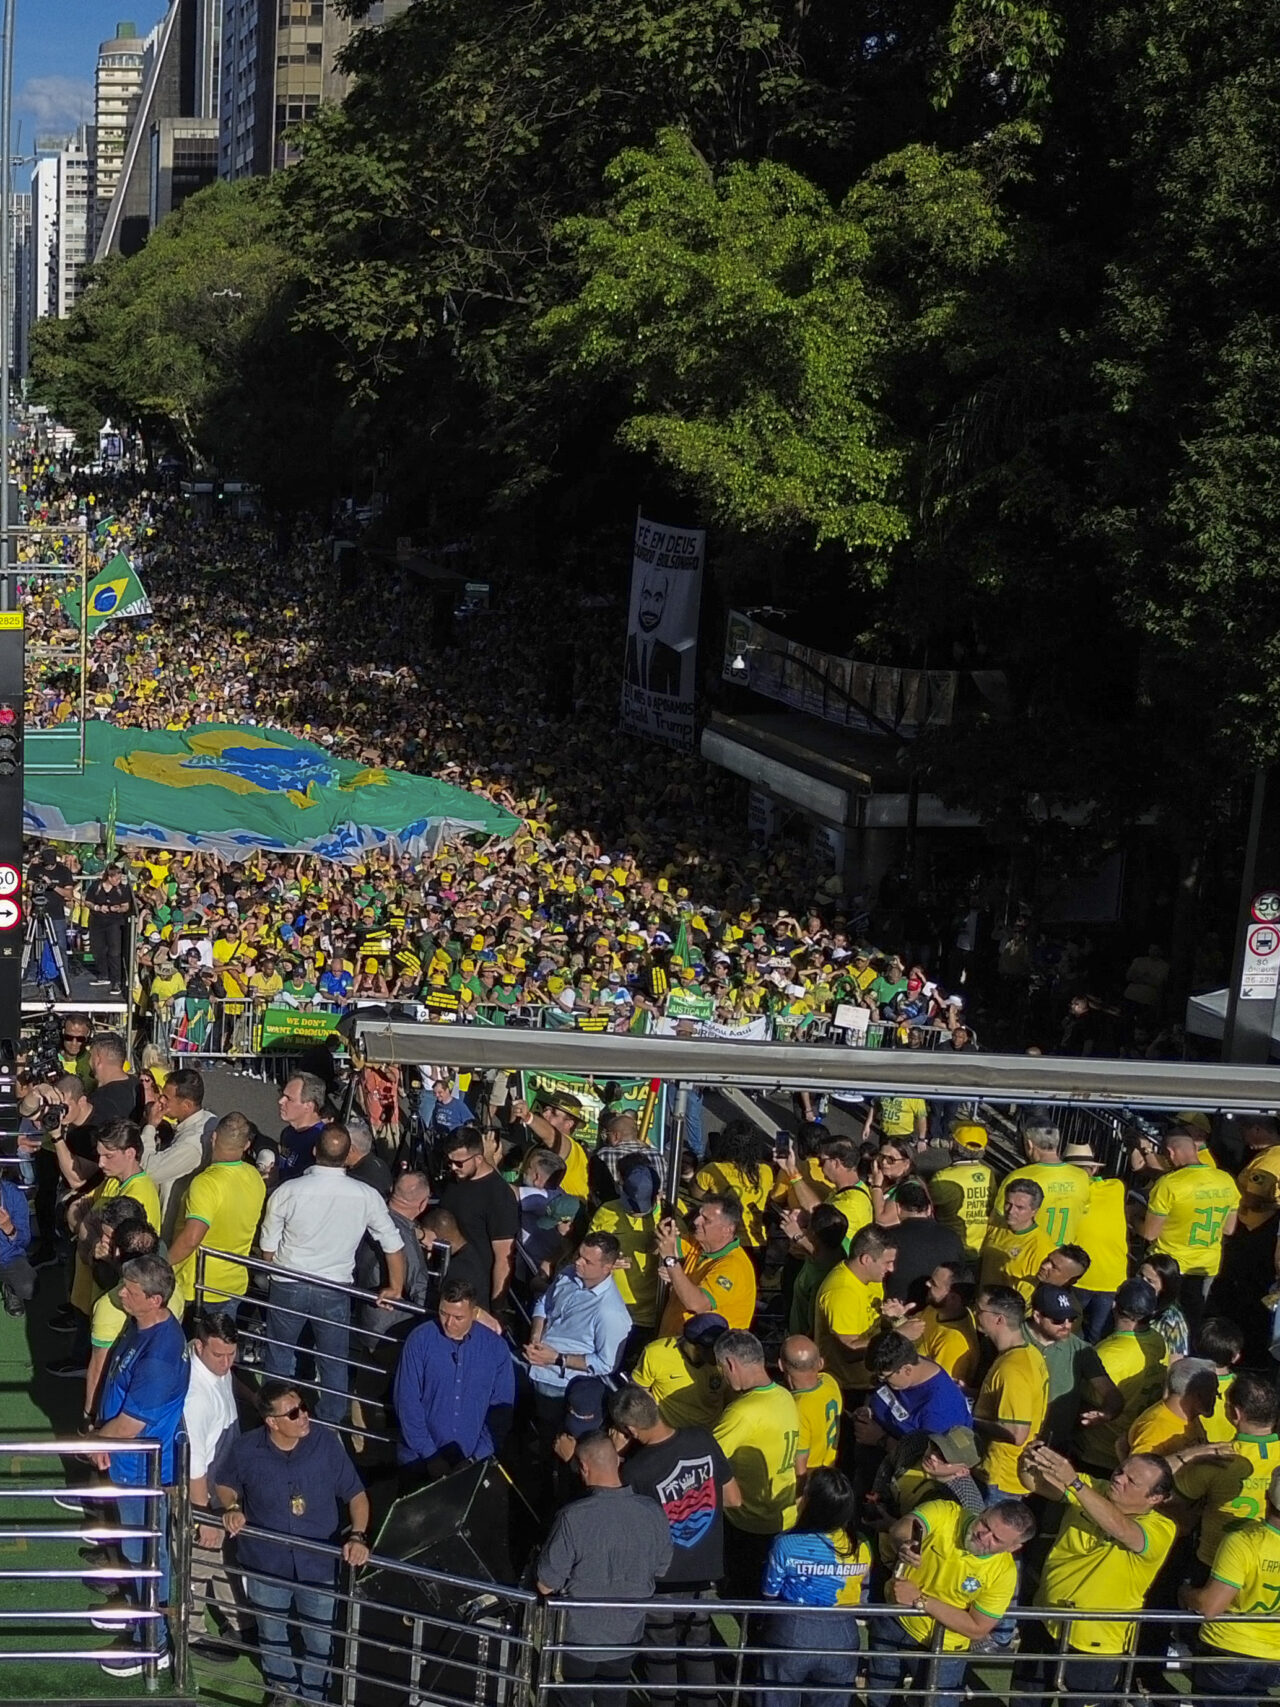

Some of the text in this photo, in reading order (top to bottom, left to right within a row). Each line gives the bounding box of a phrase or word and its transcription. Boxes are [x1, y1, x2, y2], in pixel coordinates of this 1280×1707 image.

[665, 535, 697, 555] DEUS
[652, 710, 693, 739] Trump
[1259, 897, 1280, 912] 50
[287, 1017, 300, 1025] WE
[267, 1025, 292, 1034] WANT
[1046, 1207, 1069, 1247] 11
[797, 1562, 835, 1576] LETÍCIA
